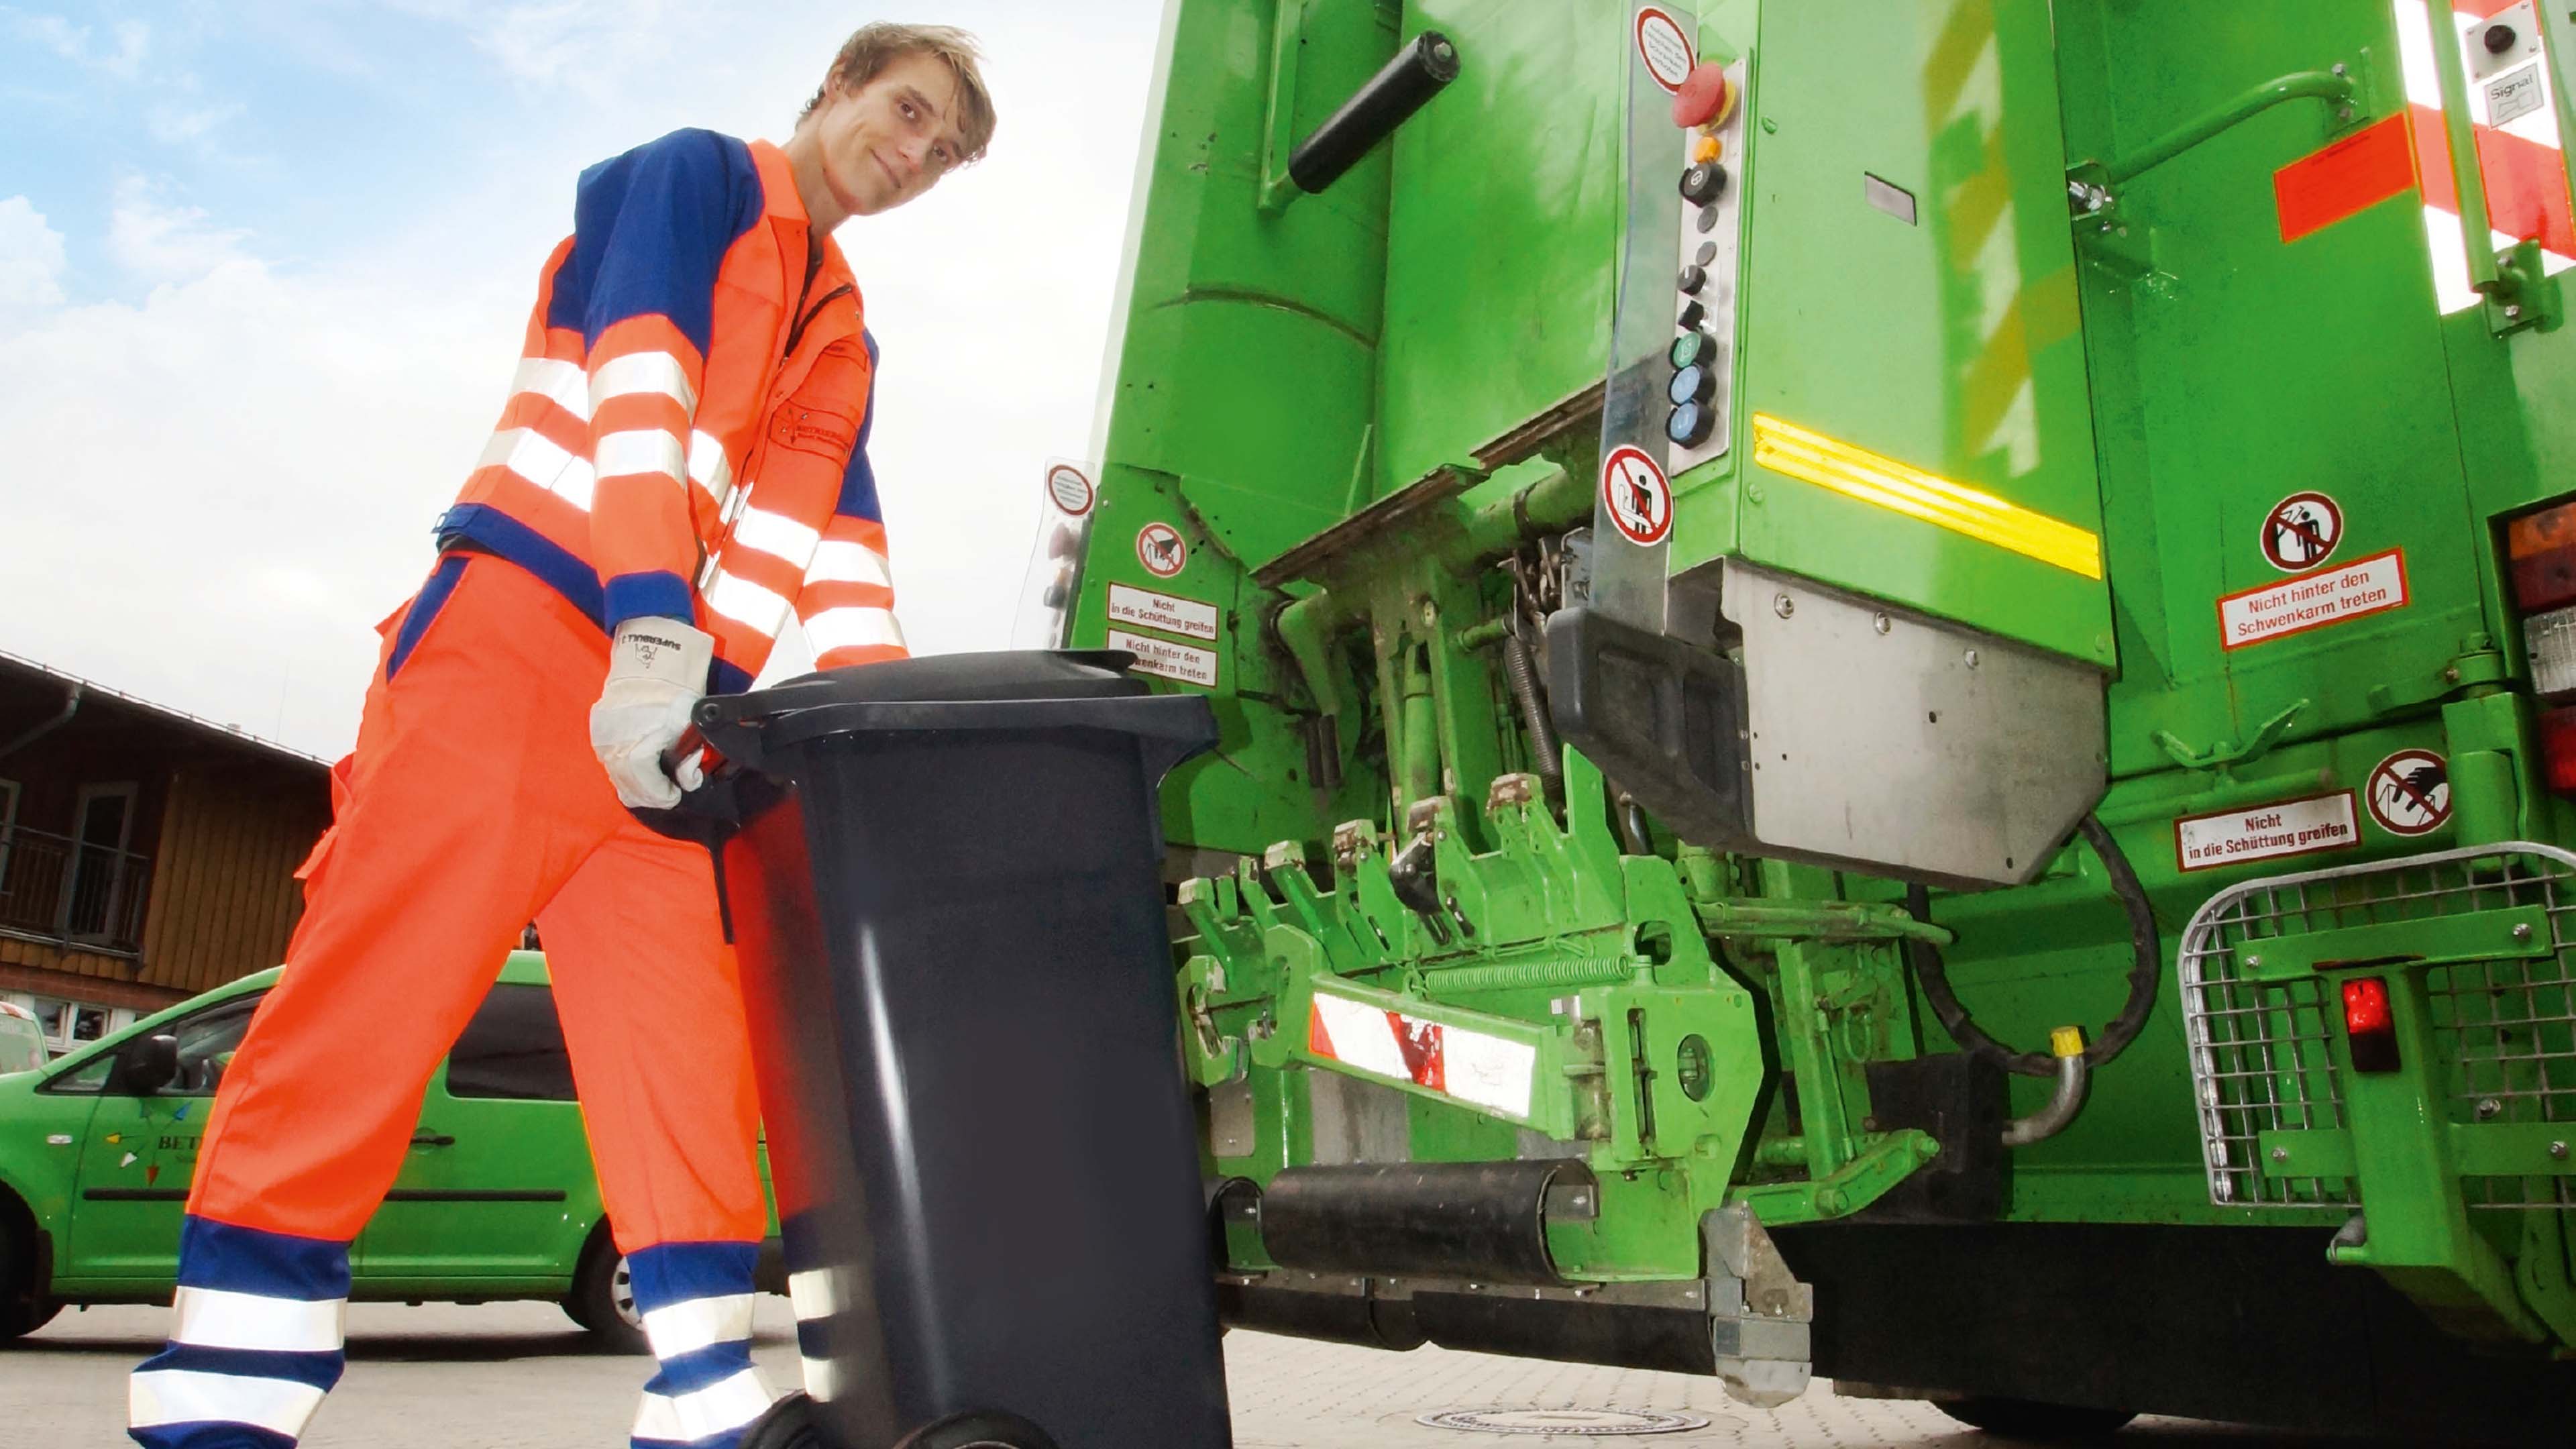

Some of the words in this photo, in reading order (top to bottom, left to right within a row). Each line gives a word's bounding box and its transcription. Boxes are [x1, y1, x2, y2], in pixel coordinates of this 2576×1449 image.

[2490, 74, 2533, 100] Signal
[1152, 598, 1175, 612] Nicht
[2249, 592, 2287, 613] Nicht
[2291, 581, 2336, 602] hinter
[2341, 572, 2369, 589] den
[1122, 606, 1135, 616] die
[1138, 608, 1182, 629] Schüttung
[1185, 620, 1214, 633] greifen
[2238, 600, 2335, 637] Schwenkarm
[2340, 588, 2386, 610] treten
[1126, 638, 1150, 653] Nicht
[1153, 645, 1181, 659] hinter
[1184, 651, 1200, 664] den
[1180, 665, 1208, 680] treten
[2245, 814, 2282, 832] Nicht
[2189, 846, 2201, 859] in
[2204, 843, 2222, 857] die
[2226, 832, 2296, 854] Schüttung
[2298, 823, 2348, 844] greifen
[158, 1136, 201, 1150] BET
